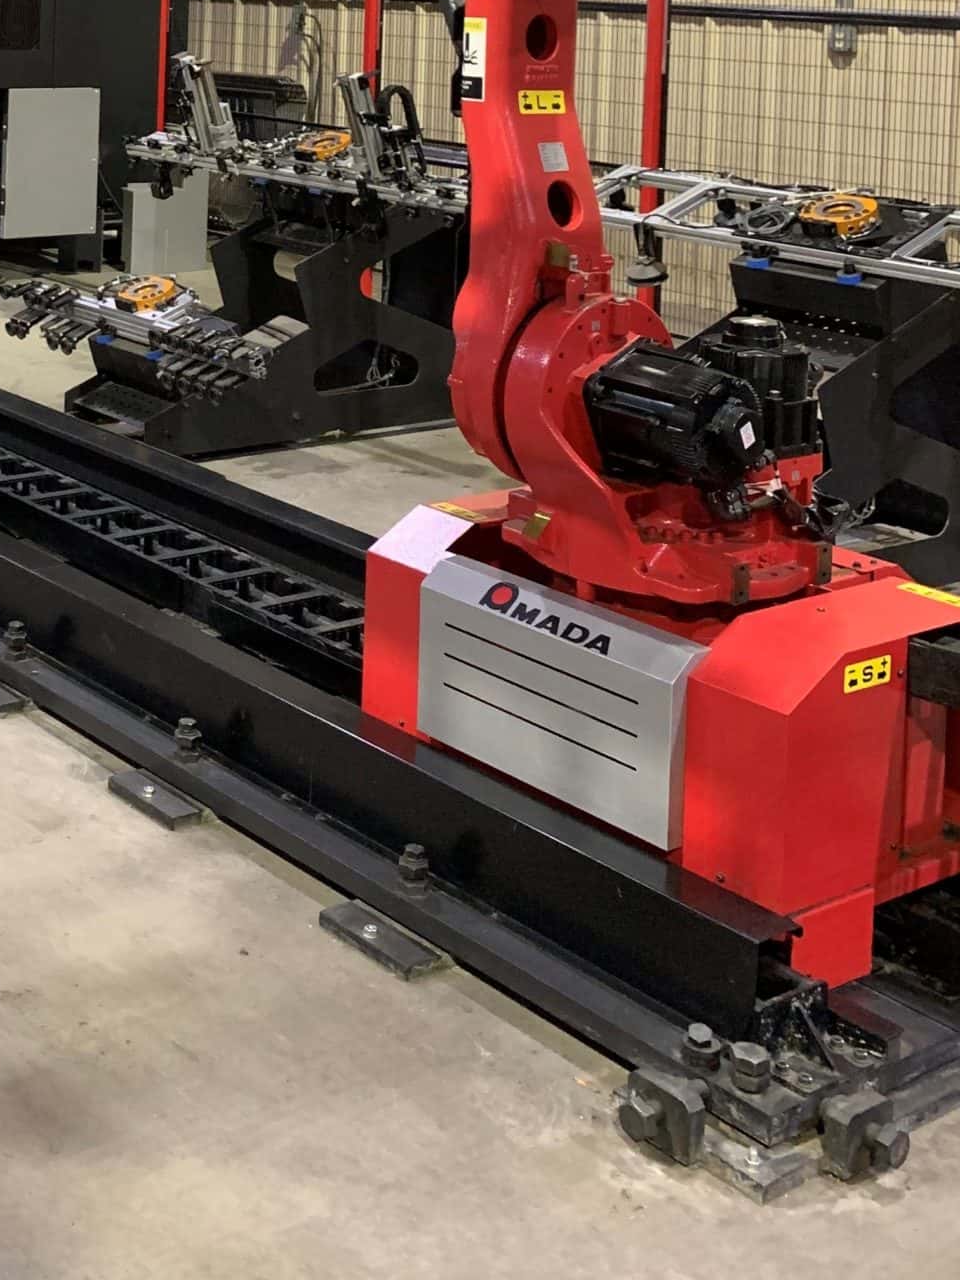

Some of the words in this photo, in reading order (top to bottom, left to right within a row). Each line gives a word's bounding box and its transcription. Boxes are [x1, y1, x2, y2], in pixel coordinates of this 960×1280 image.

[536, 95, 548, 110] L
[479, 581, 612, 656] AMADA
[862, 665, 874, 682] S
